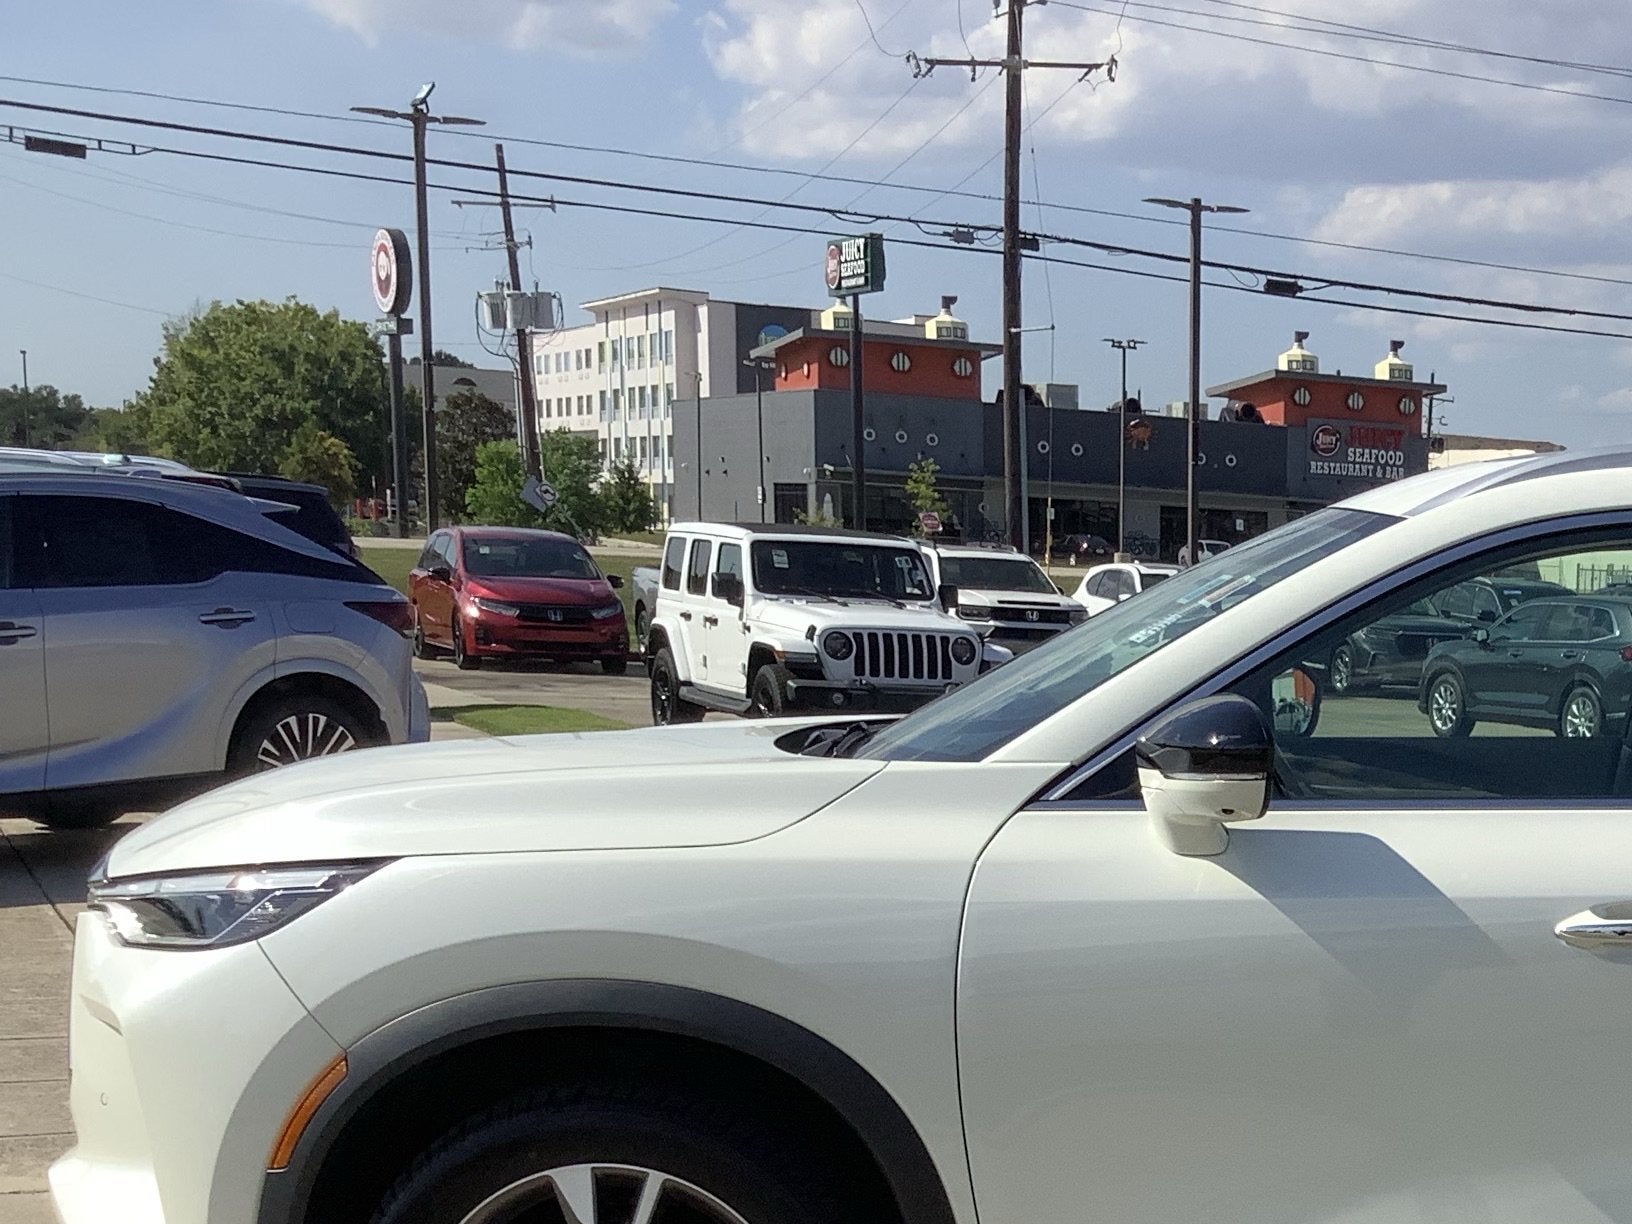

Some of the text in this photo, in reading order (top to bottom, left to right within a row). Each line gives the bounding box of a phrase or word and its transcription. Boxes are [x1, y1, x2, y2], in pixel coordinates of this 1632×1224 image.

[840, 238, 865, 262] JUICY
[841, 260, 865, 277] SEAFOOD
[1347, 448, 1404, 465] SEAFOOD
[1310, 461, 1404, 480] RESTAURANT & BAR
